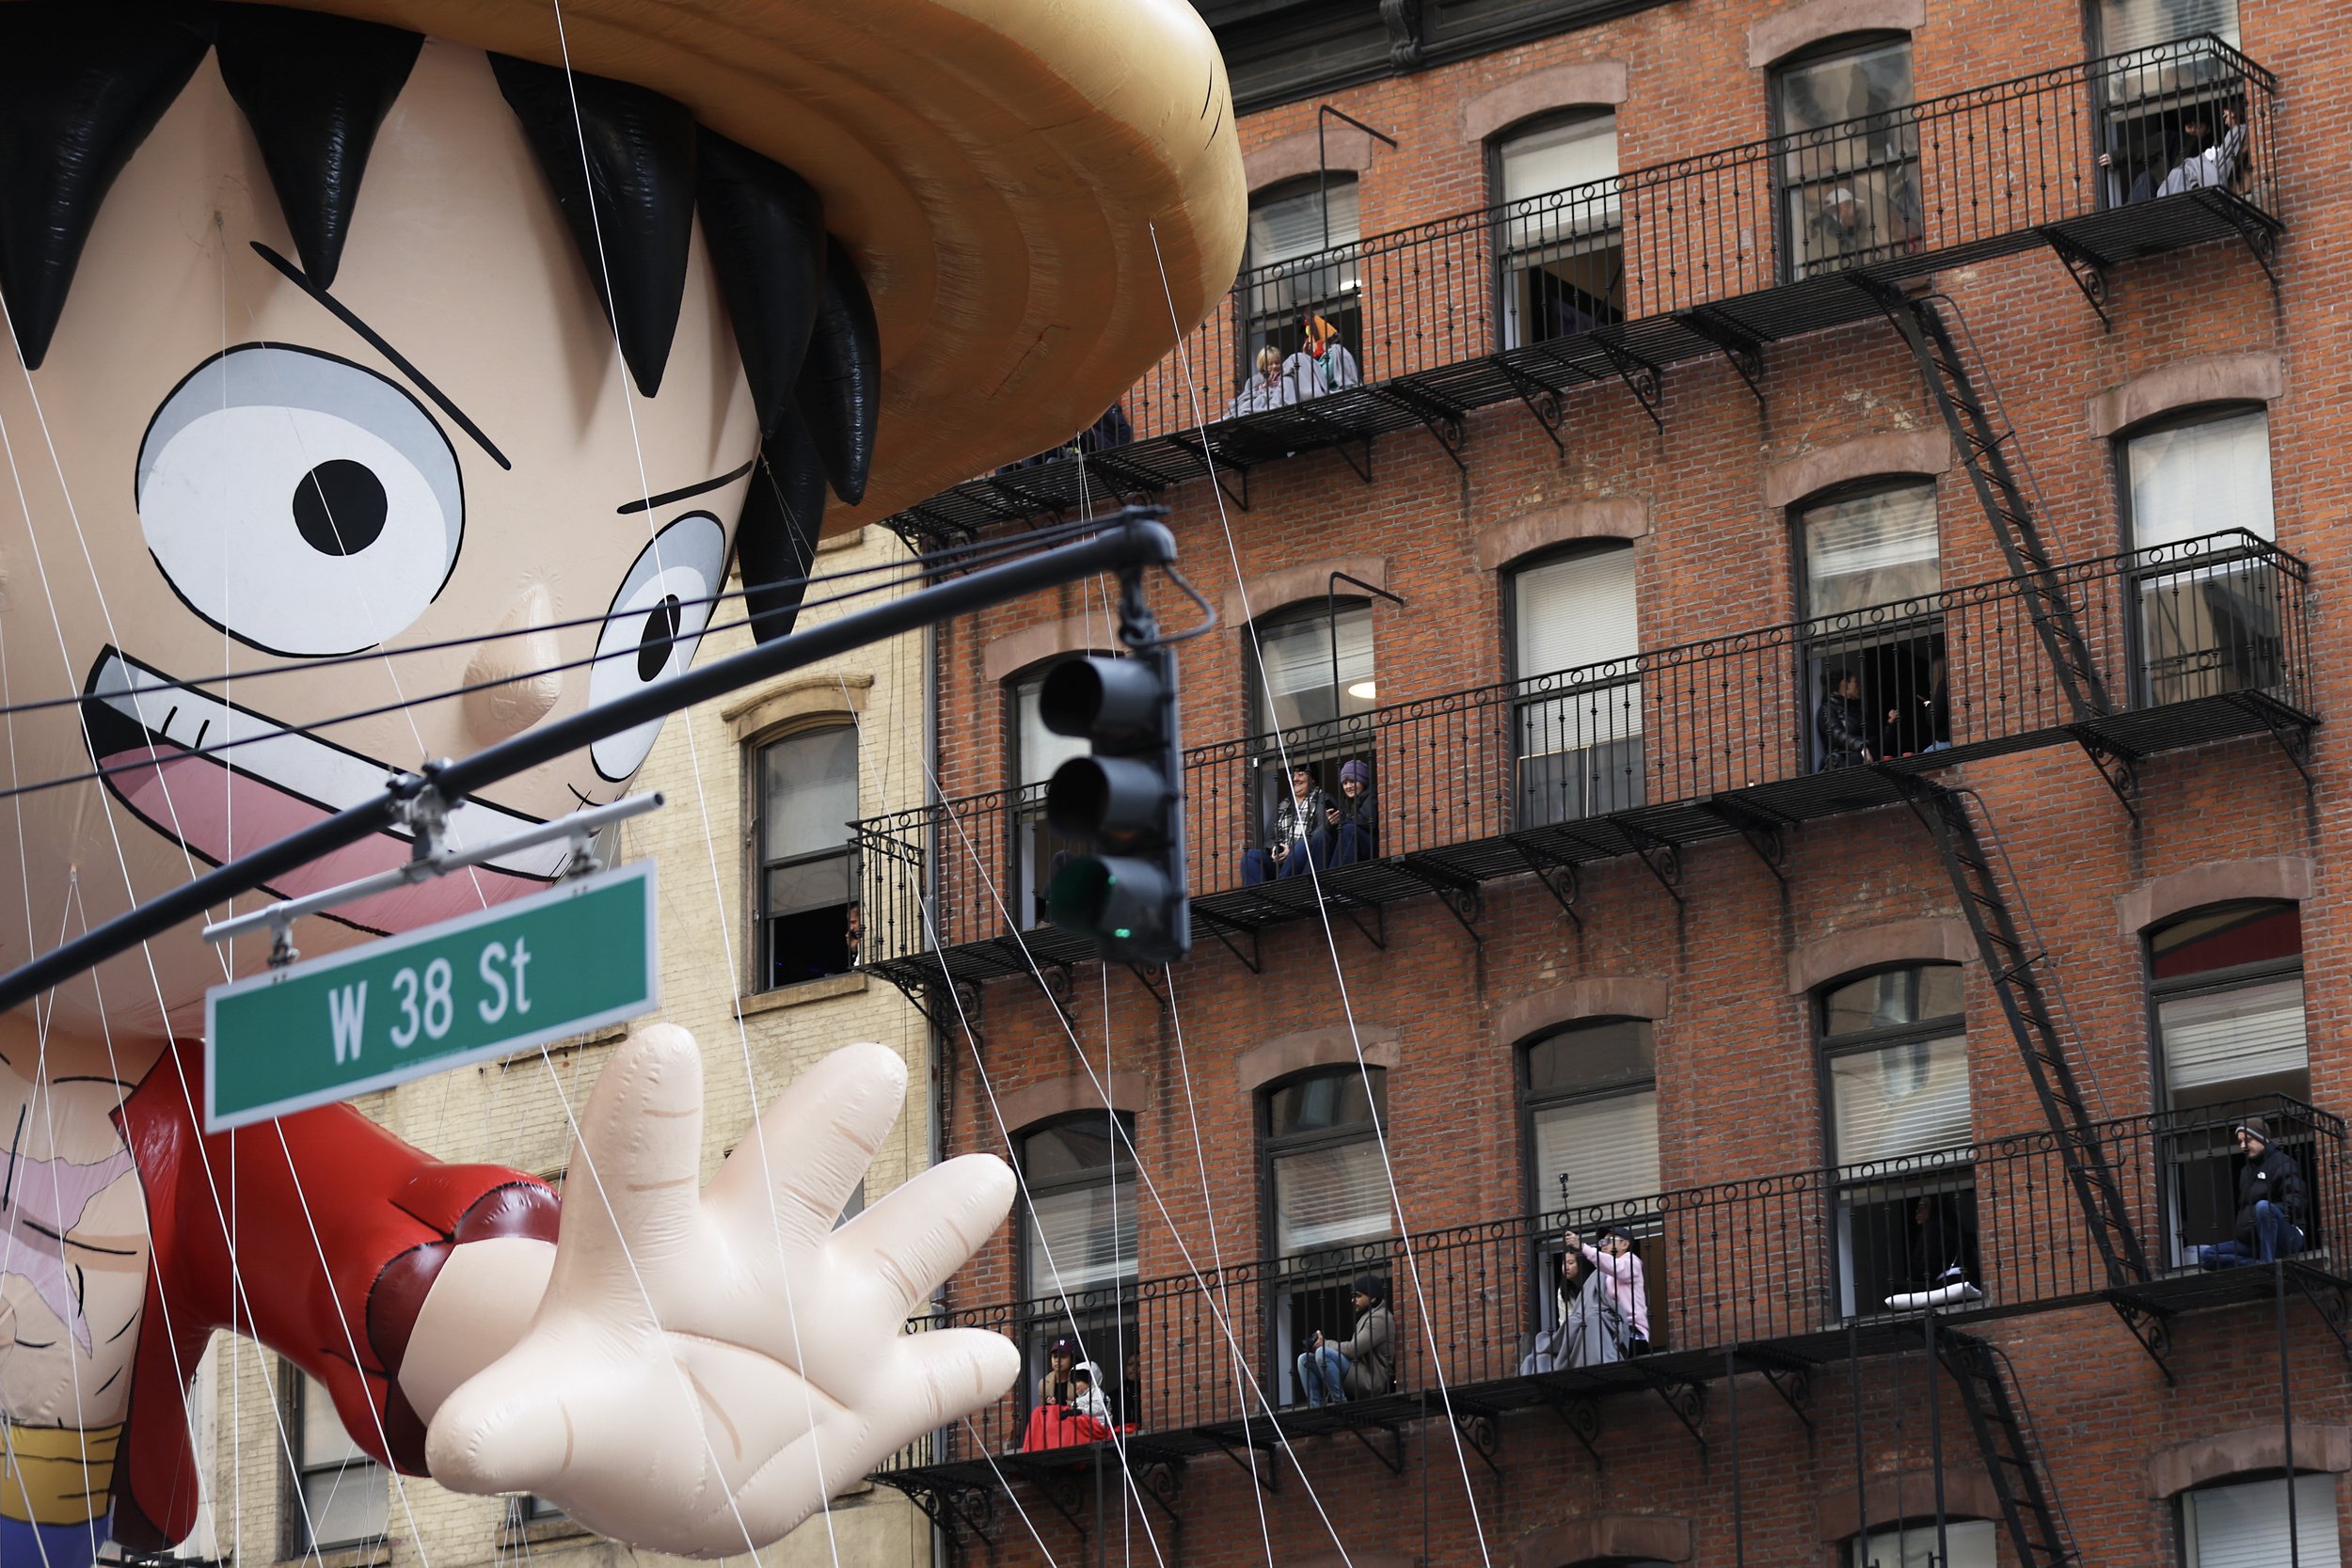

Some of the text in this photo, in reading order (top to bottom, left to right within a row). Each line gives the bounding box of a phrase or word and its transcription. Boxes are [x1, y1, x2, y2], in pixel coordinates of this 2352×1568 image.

[328, 936, 531, 1065] W 38 St
